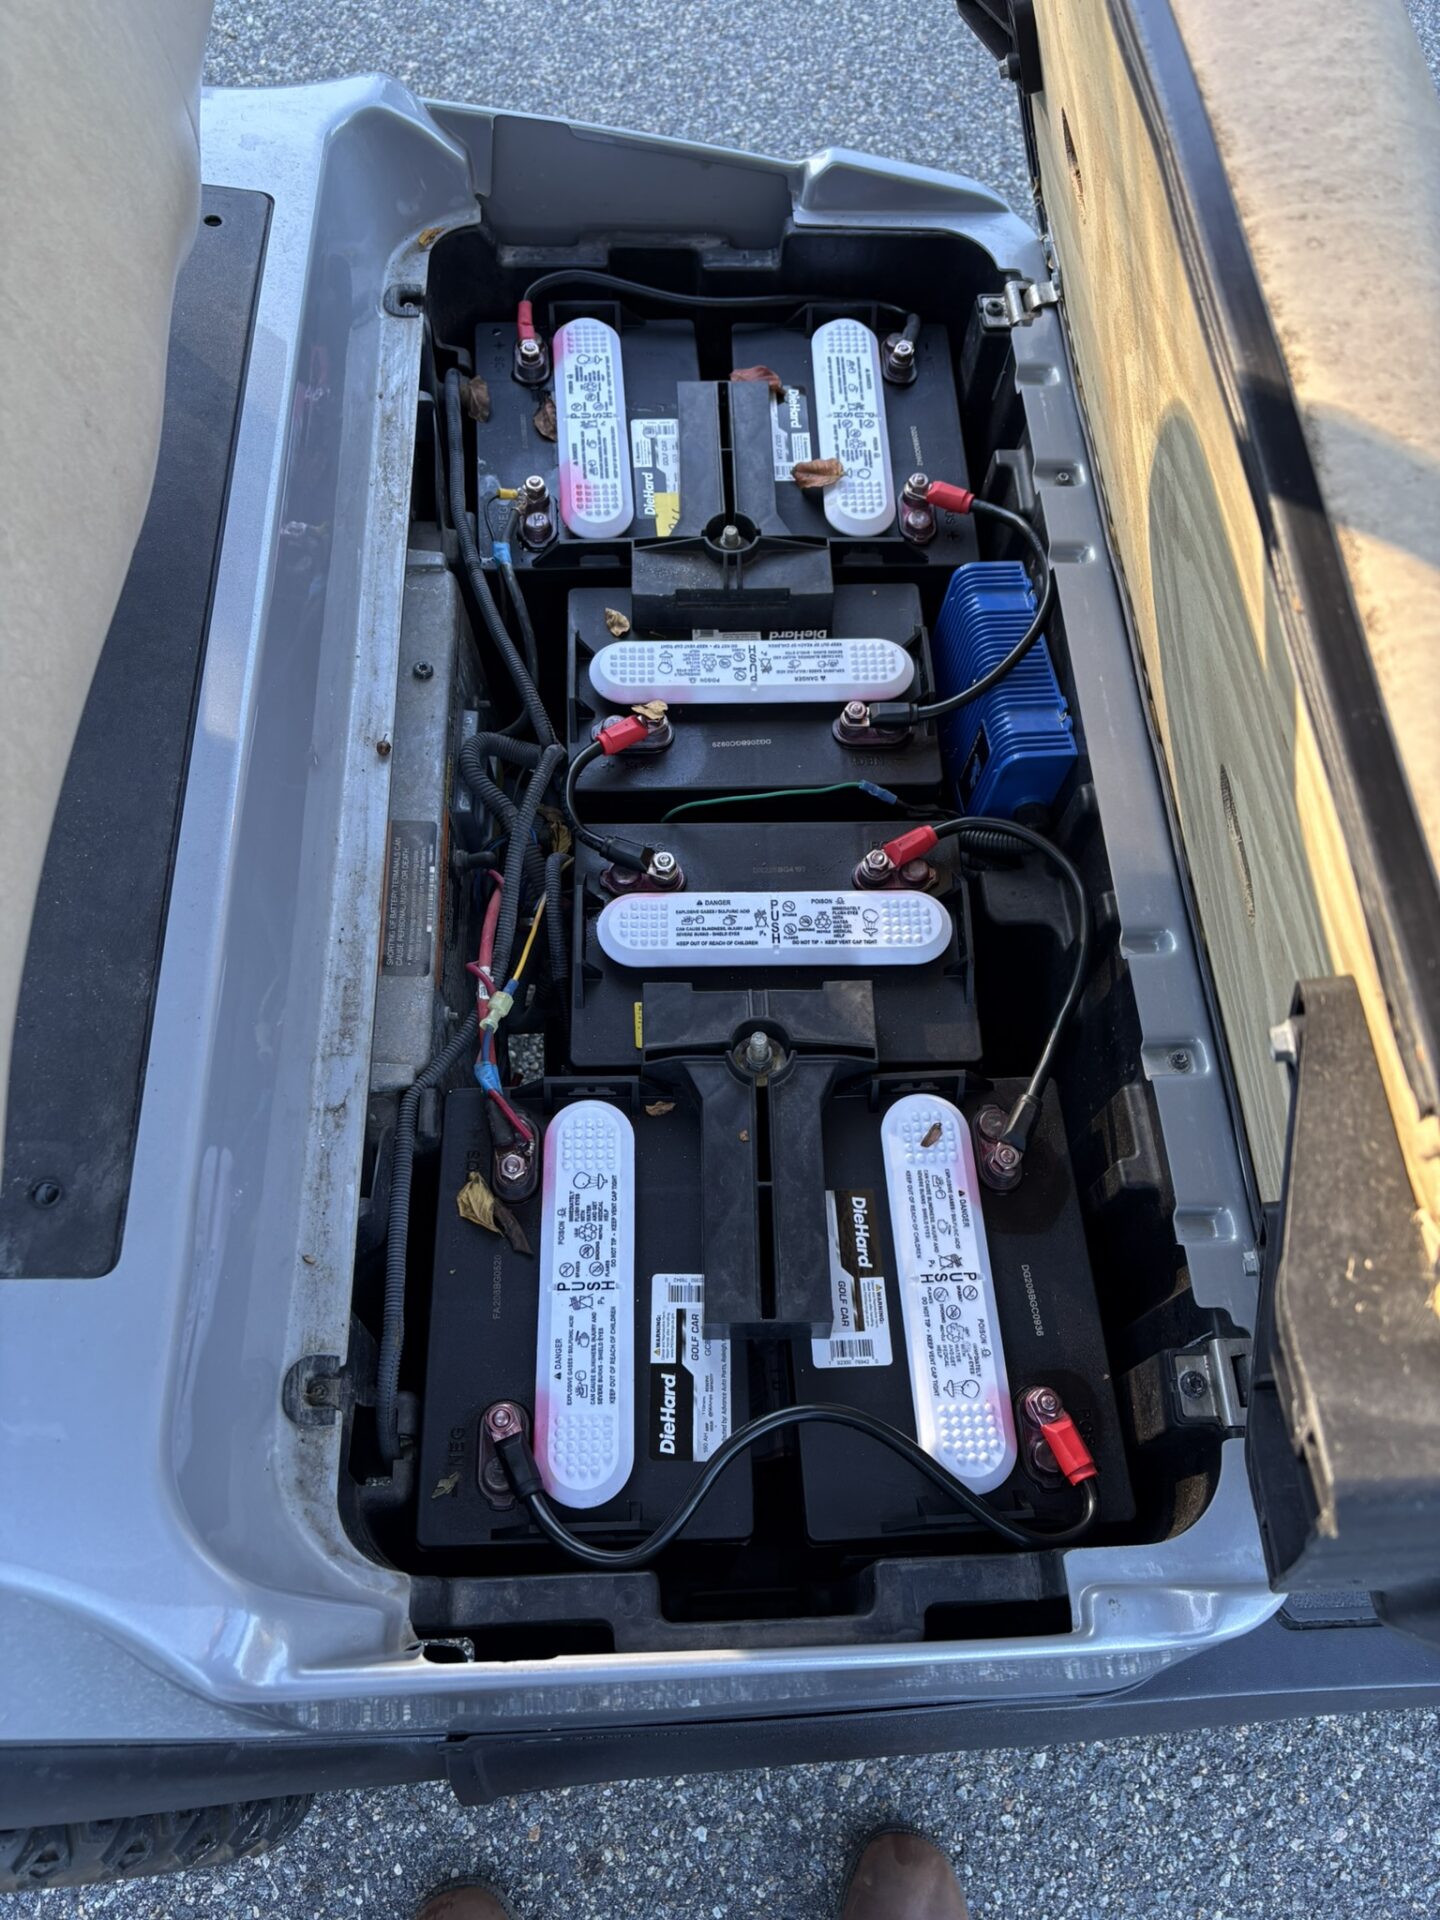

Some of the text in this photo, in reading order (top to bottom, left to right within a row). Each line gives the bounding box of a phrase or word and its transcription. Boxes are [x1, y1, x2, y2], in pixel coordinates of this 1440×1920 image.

[789, 389, 801, 427] DieHard
[643, 472, 655, 515] DieHard
[769, 629, 827, 640] DieHard
[748, 644, 758, 682] PUSH
[392, 852, 400, 888] TERMINALS
[389, 890, 398, 918] BATTERY
[390, 919, 396, 929] OF
[770, 900, 780, 944] PUSH
[387, 930, 396, 966] SHORTING
[910, 1204, 918, 1222] REACH
[960, 1199, 970, 1228] DANGER
[851, 1196, 874, 1269] DieHard
[913, 1232, 922, 1259] CHILDREN
[556, 1281, 615, 1291] PUSH
[920, 1272, 977, 1284] PUSH
[838, 1280, 850, 1327] GOLF CAR
[921, 1296, 928, 1306] DO
[691, 1313, 700, 1361] GOLF CAR
[977, 1319, 988, 1345] POISON
[554, 1338, 562, 1370] DANGER
[609, 1366, 616, 1374] OF
[658, 1372, 676, 1454] DieHard
[448, 1426, 466, 1467] NEG
